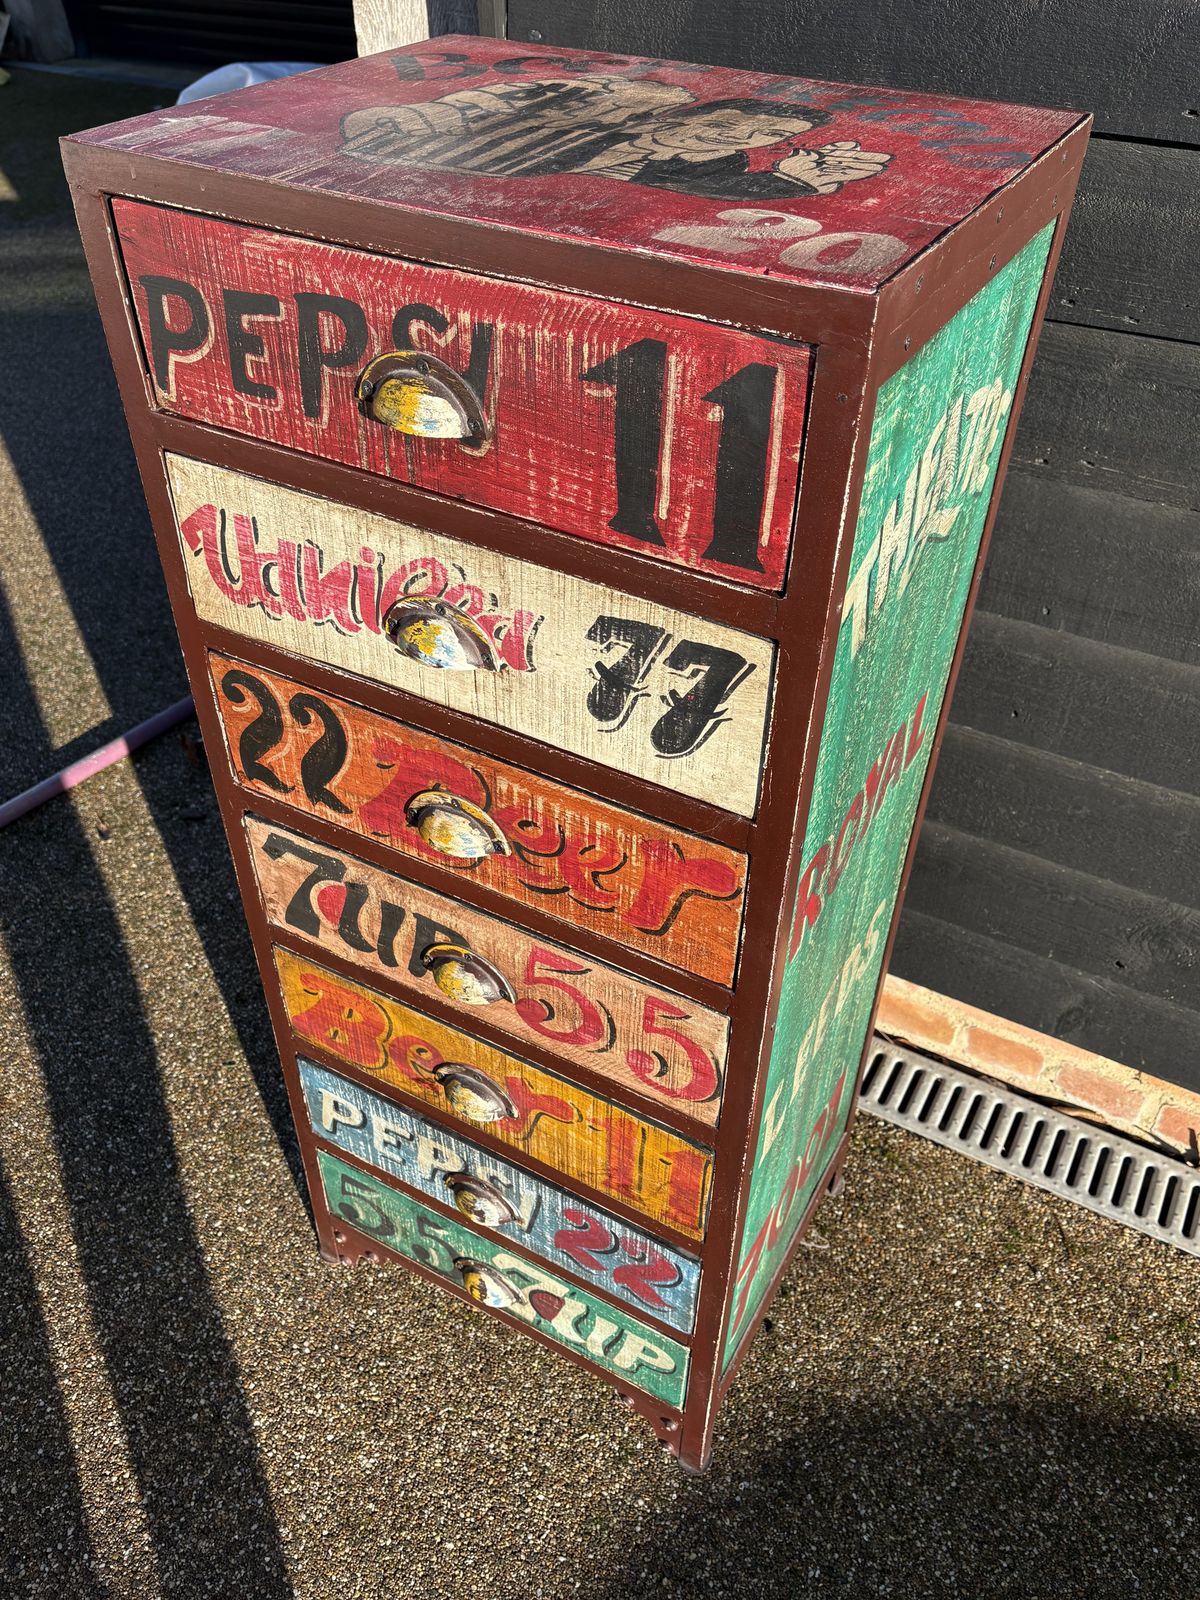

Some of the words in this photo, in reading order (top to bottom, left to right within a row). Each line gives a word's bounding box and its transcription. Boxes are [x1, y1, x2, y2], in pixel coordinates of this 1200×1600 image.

[651, 207, 910, 274] 20
[579, 338, 785, 575] 11
[222, 668, 354, 815] 22
[586, 614, 758, 760] 77
[788, 690, 930, 964] ROYAL
[262, 832, 471, 978] 7UP
[514, 945, 722, 1104] 55
[757, 898, 887, 1169] LEEDS
[291, 972, 583, 1141] Ber
[583, 1115, 713, 1236] 11
[728, 1065, 849, 1345] 7001
[338, 1173, 470, 1288] 55
[491, 1253, 677, 1375] 7UP
[554, 1208, 684, 1313] 22
